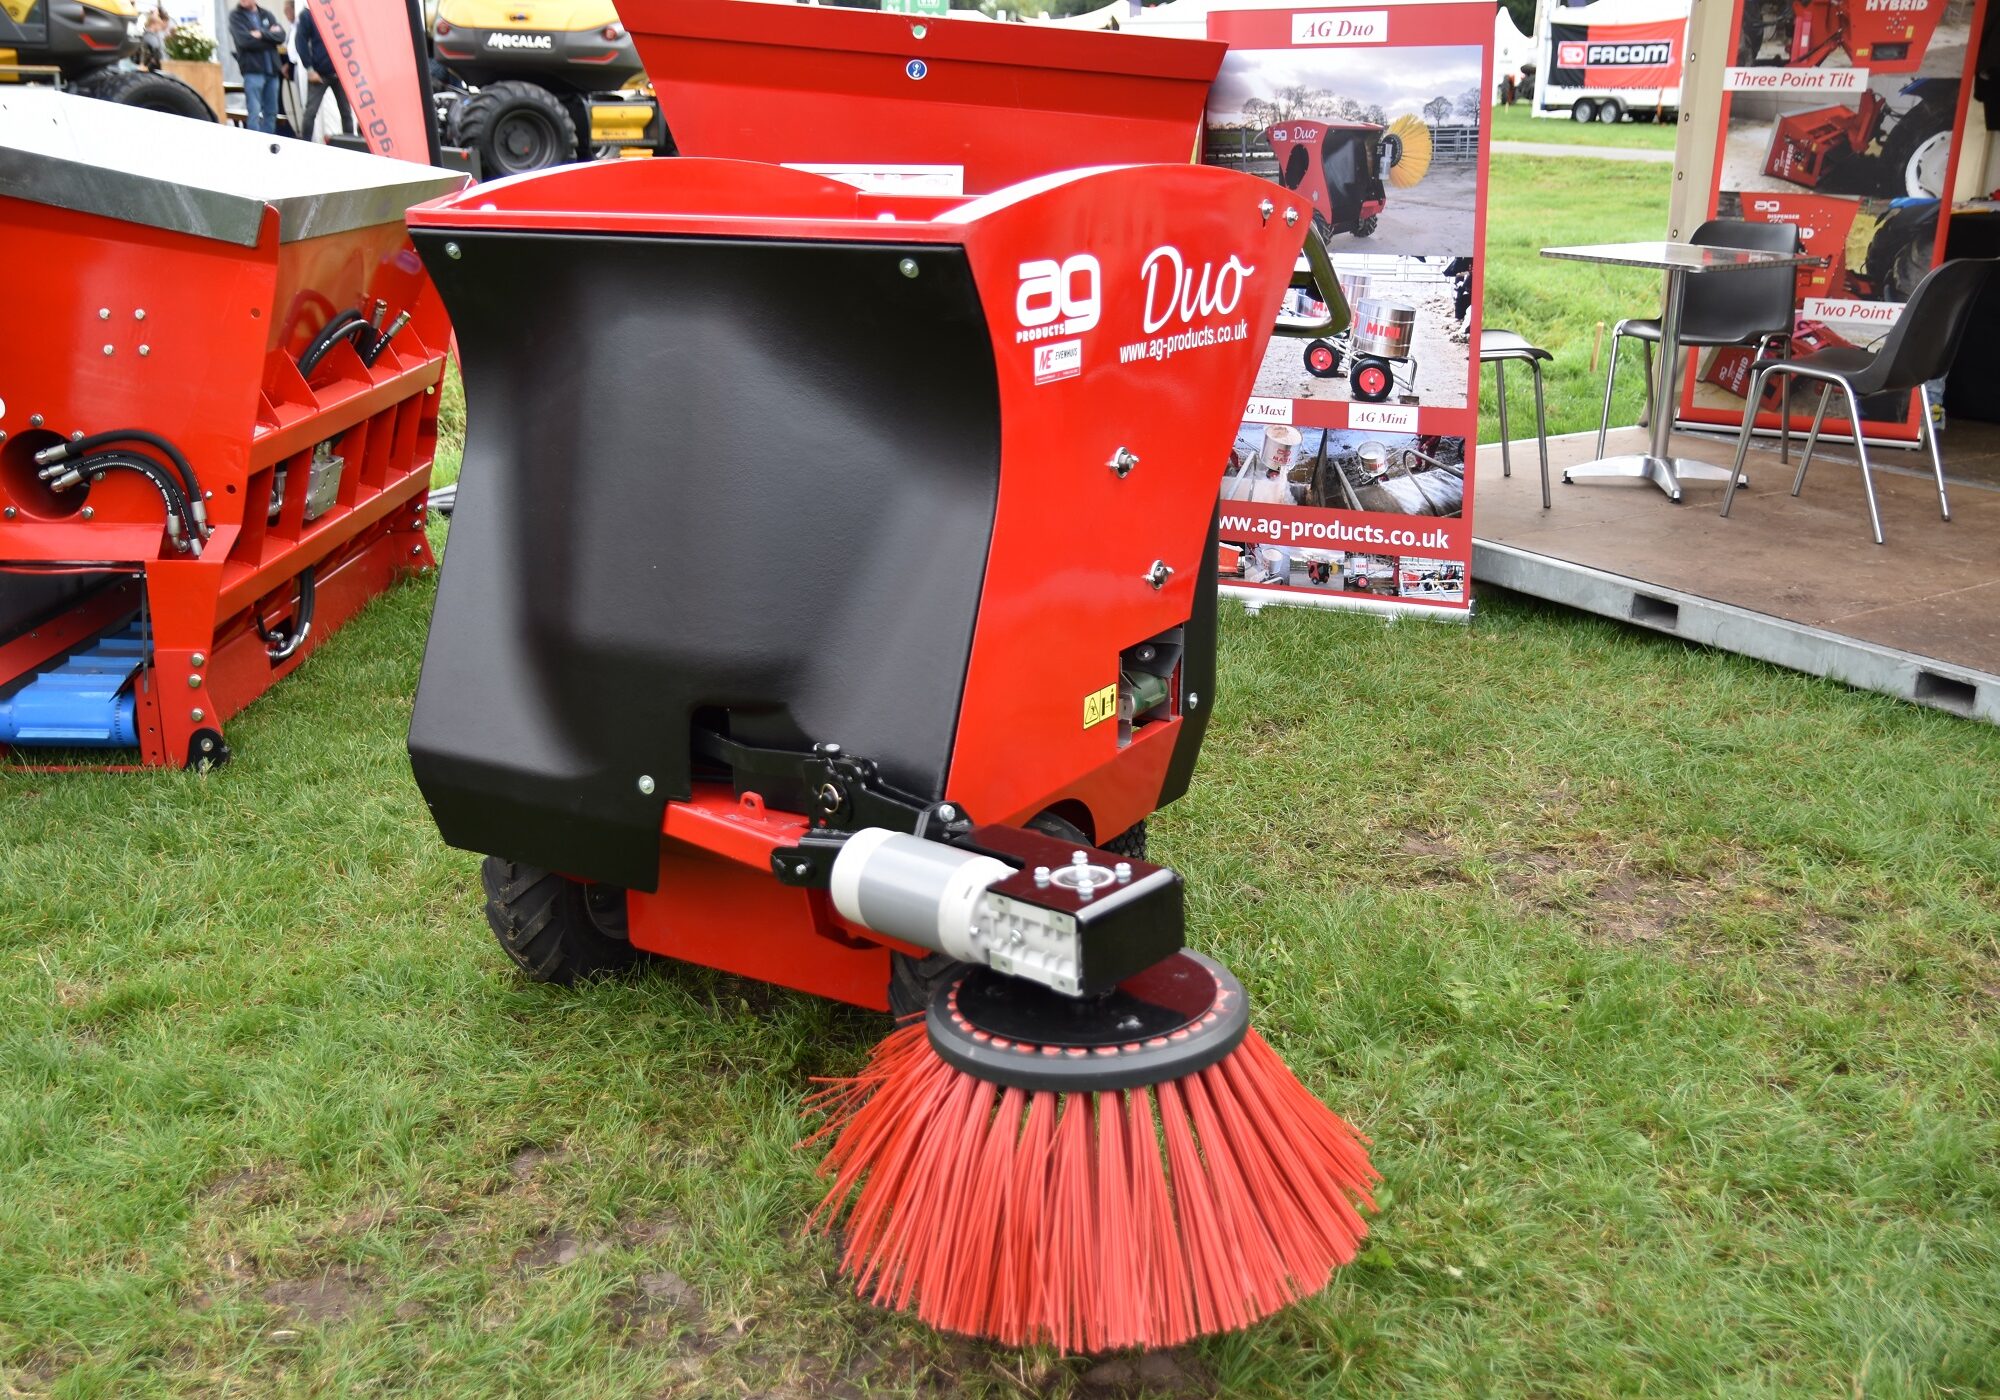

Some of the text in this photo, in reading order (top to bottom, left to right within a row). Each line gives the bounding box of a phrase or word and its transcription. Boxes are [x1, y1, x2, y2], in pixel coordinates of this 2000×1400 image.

[1865, 0, 1929, 12] HYBRID
[1302, 19, 1374, 38] AG Duo
[1588, 43, 1669, 64] FACOM
[1734, 72, 1856, 87] Three Point Tilt
[1293, 126, 1318, 140] Duo
[1754, 200, 1780, 213] ag
[1016, 254, 1100, 336] ag
[1141, 245, 1255, 334] Duo
[1814, 302, 1846, 317] Two
[1849, 304, 1893, 320] Point
[1016, 324, 1066, 343] PRODUCTS
[1365, 321, 1401, 341] MINI
[1119, 318, 1248, 364] www.ag-products.co.uk
[1730, 356, 1749, 393] HYBRID
[1257, 404, 1287, 416] Maxi
[1355, 411, 1408, 426] AG Mini
